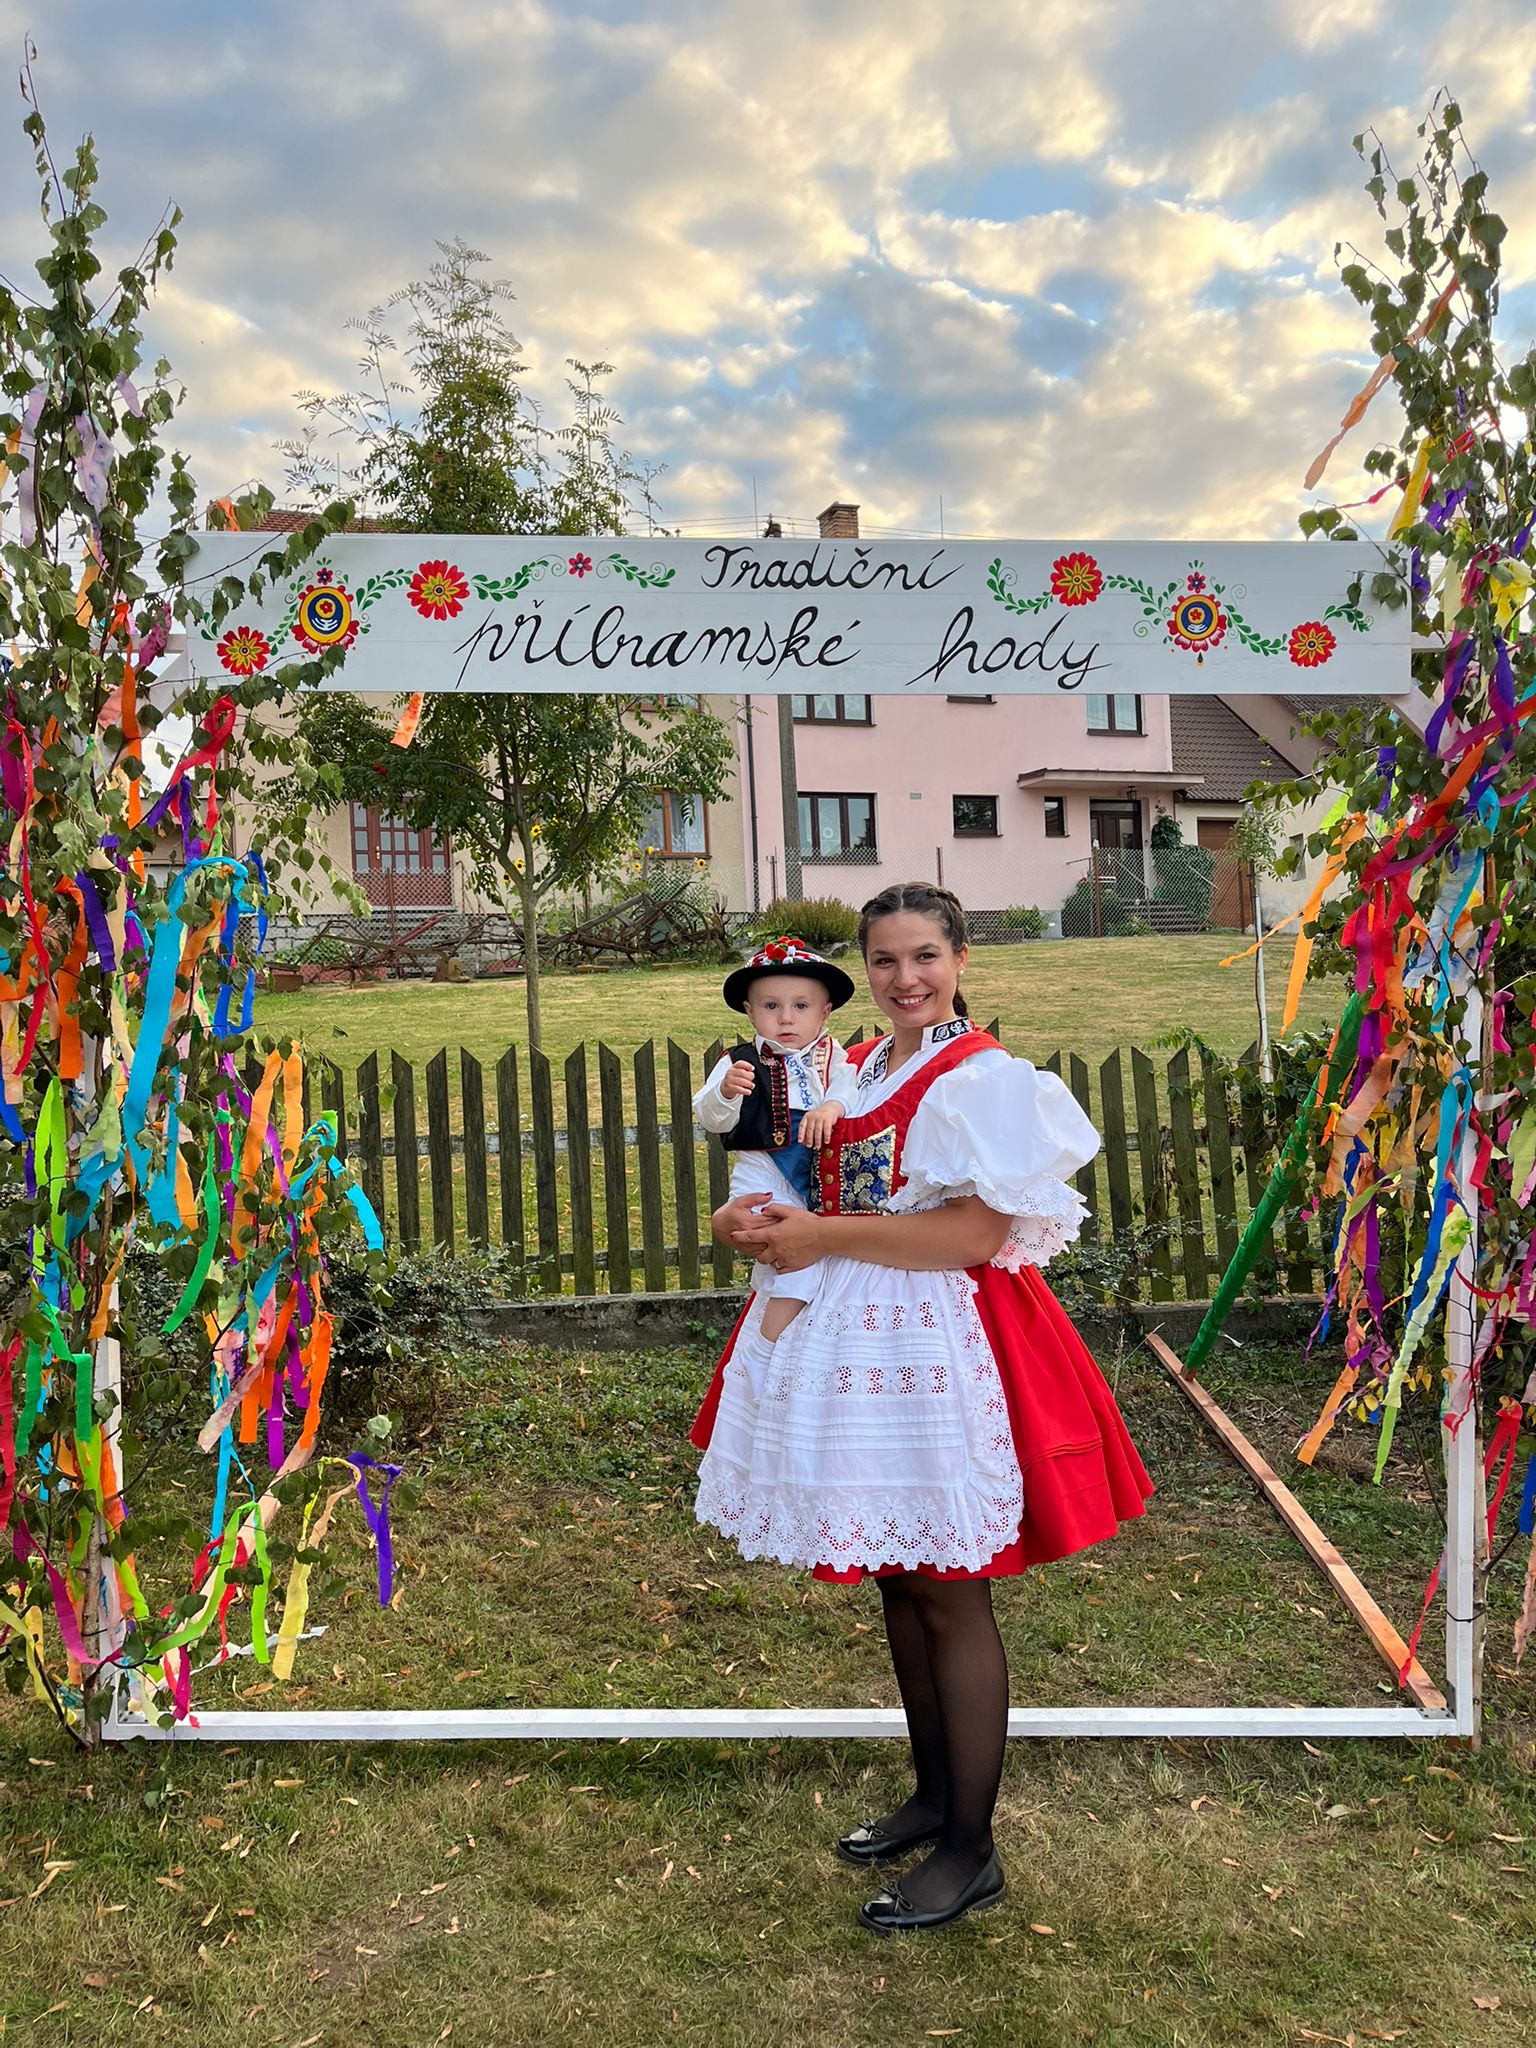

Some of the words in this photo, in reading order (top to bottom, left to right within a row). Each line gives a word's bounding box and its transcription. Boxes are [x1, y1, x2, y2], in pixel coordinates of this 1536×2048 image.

[701, 543, 966, 591] Tradiční
[453, 600, 862, 690] příbramské
[905, 605, 1112, 690] hody
